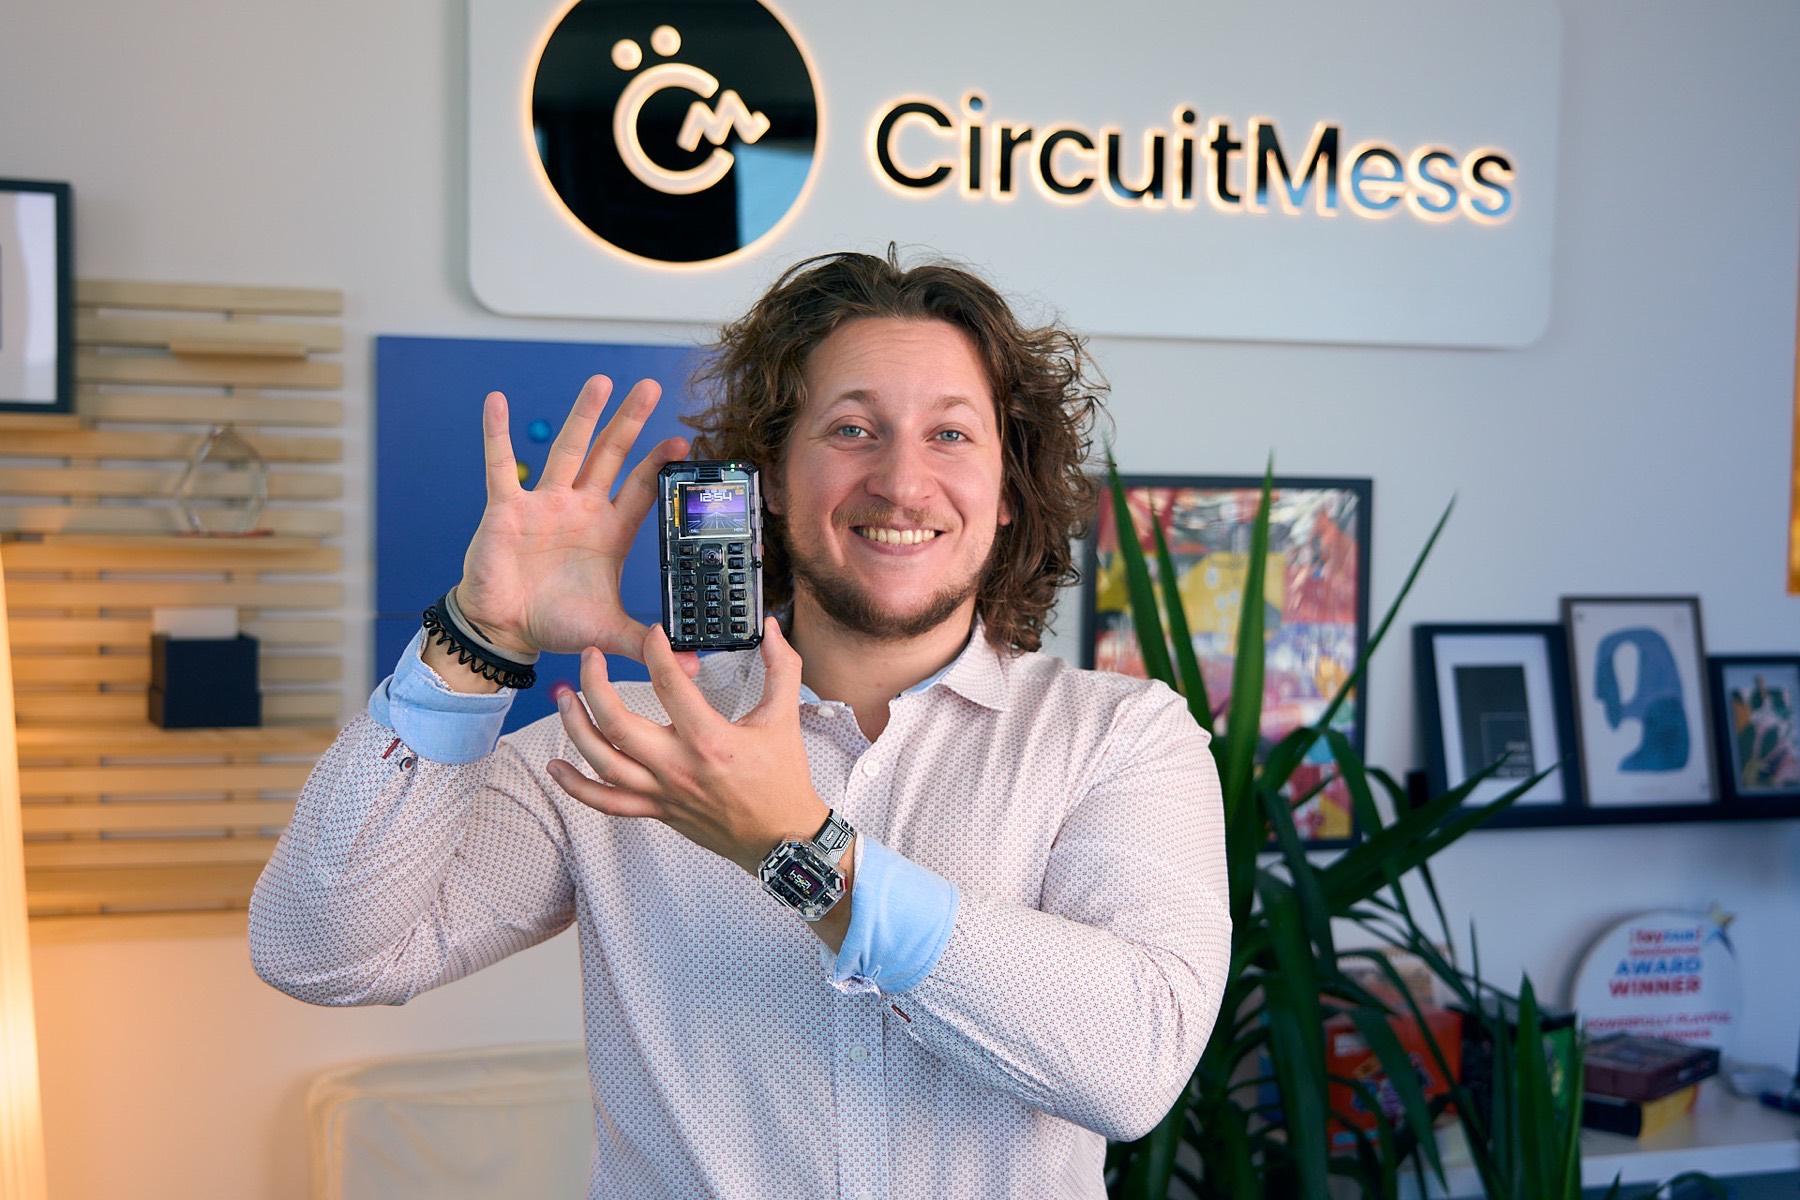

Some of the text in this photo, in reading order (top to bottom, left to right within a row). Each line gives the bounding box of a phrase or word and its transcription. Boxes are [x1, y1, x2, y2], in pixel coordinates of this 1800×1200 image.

[876, 95, 1513, 218] CircuitMess
[700, 492, 732, 502] 12:54
[1615, 958, 1702, 976] AWARD
[1608, 976, 1701, 998] WINNER
